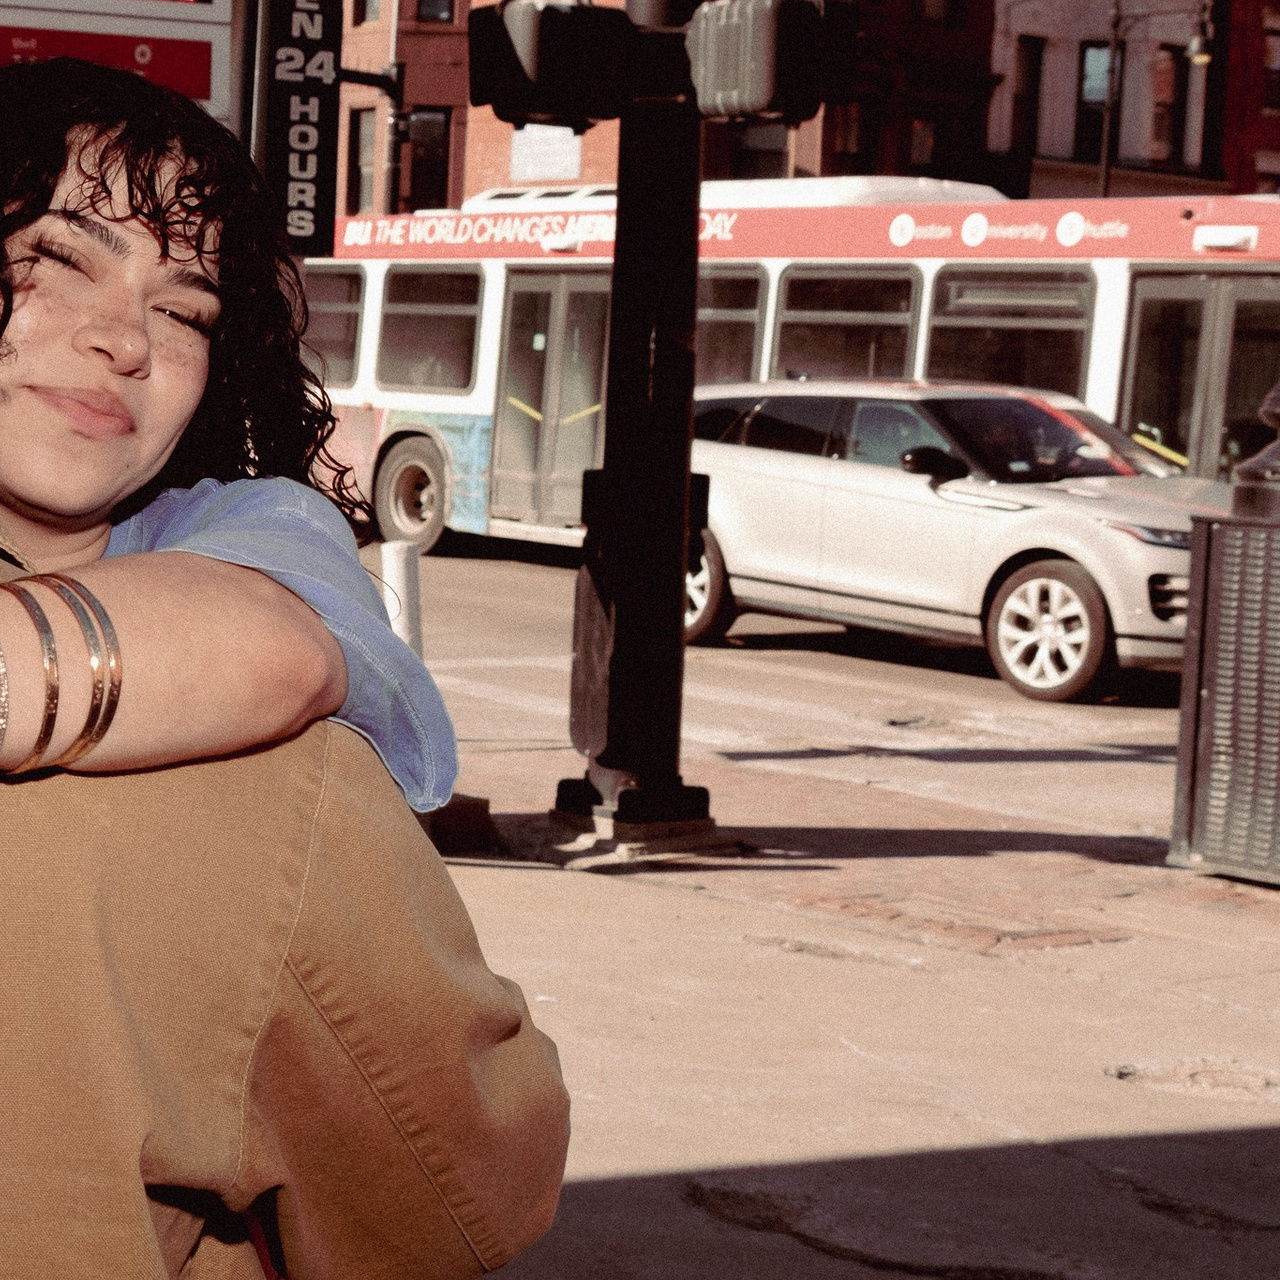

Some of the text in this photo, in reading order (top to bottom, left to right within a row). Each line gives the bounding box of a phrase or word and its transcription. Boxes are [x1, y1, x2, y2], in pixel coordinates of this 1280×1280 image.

[275, 46, 336, 85] 24
[287, 95, 320, 237] HOURS
[375, 219, 407, 245] THE
[408, 218, 471, 244] WORLD
[472, 214, 565, 243] CHANGES
